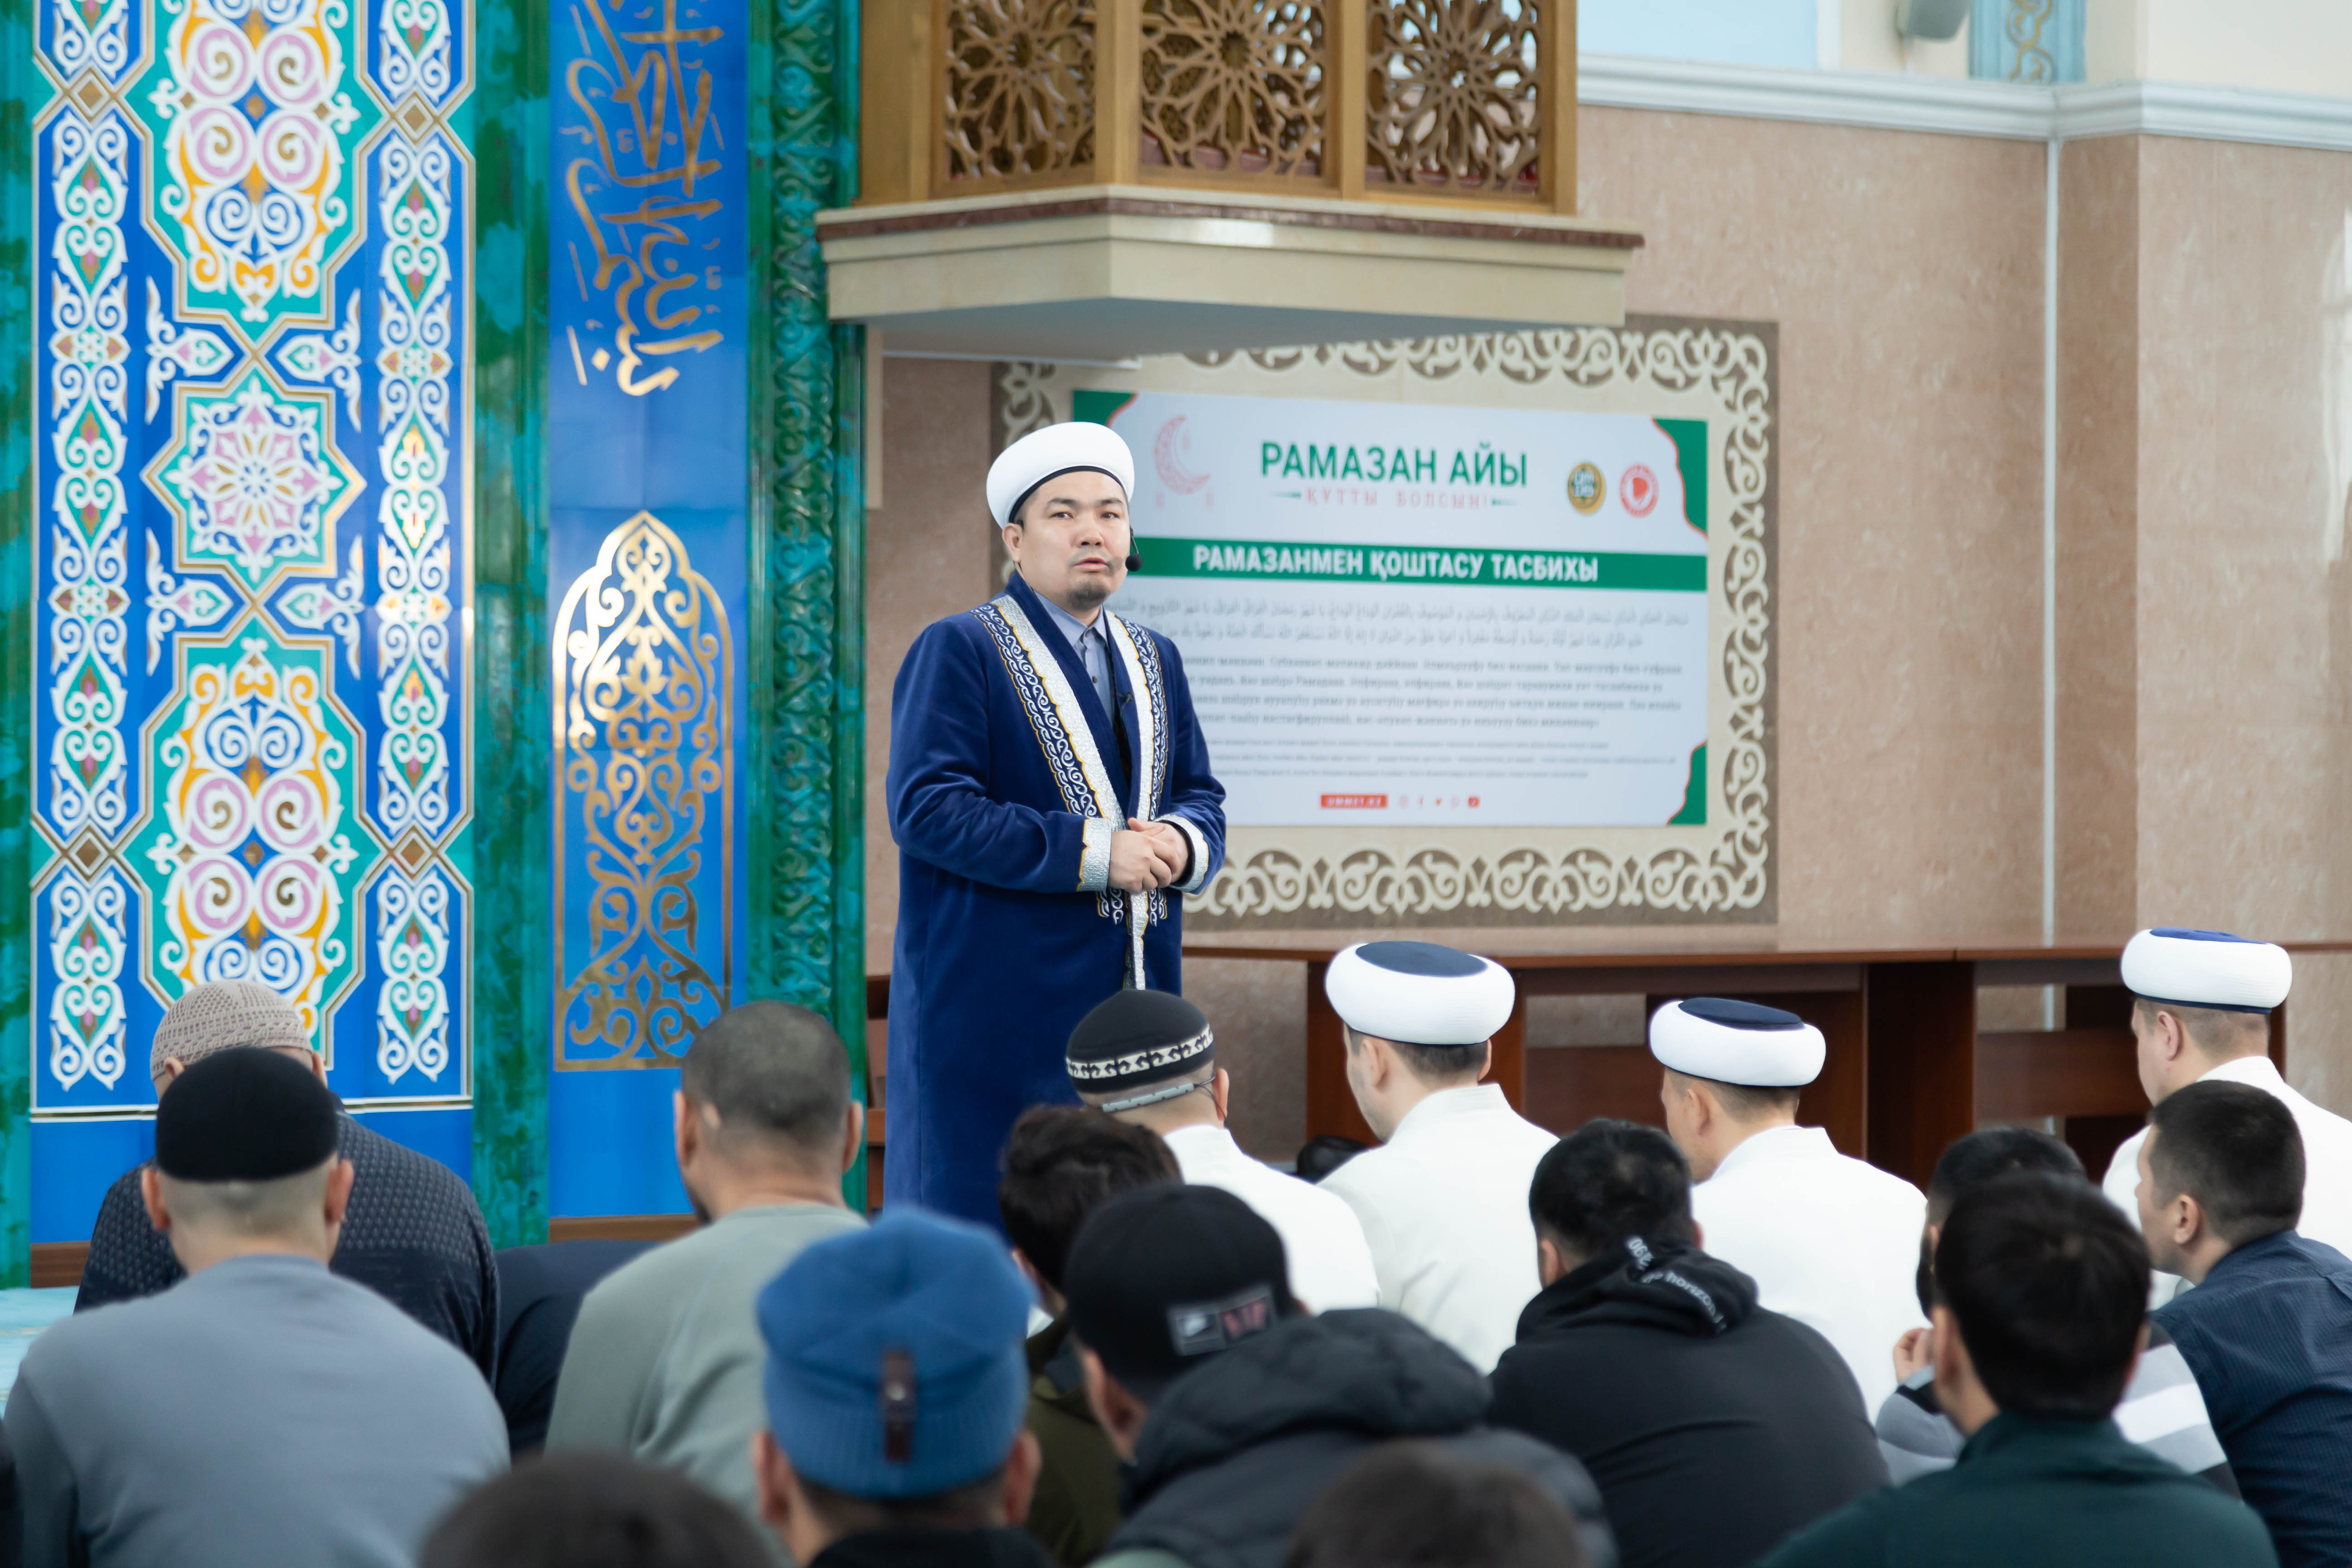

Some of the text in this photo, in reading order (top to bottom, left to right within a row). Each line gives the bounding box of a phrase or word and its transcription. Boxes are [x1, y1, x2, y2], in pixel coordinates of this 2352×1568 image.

[1261, 441, 1526, 486] РАМАЗАН АЙЫ
[1193, 544, 1599, 583] РАМАЗАНМЕН ҚОШТАСУ ТАСБИХЫ
